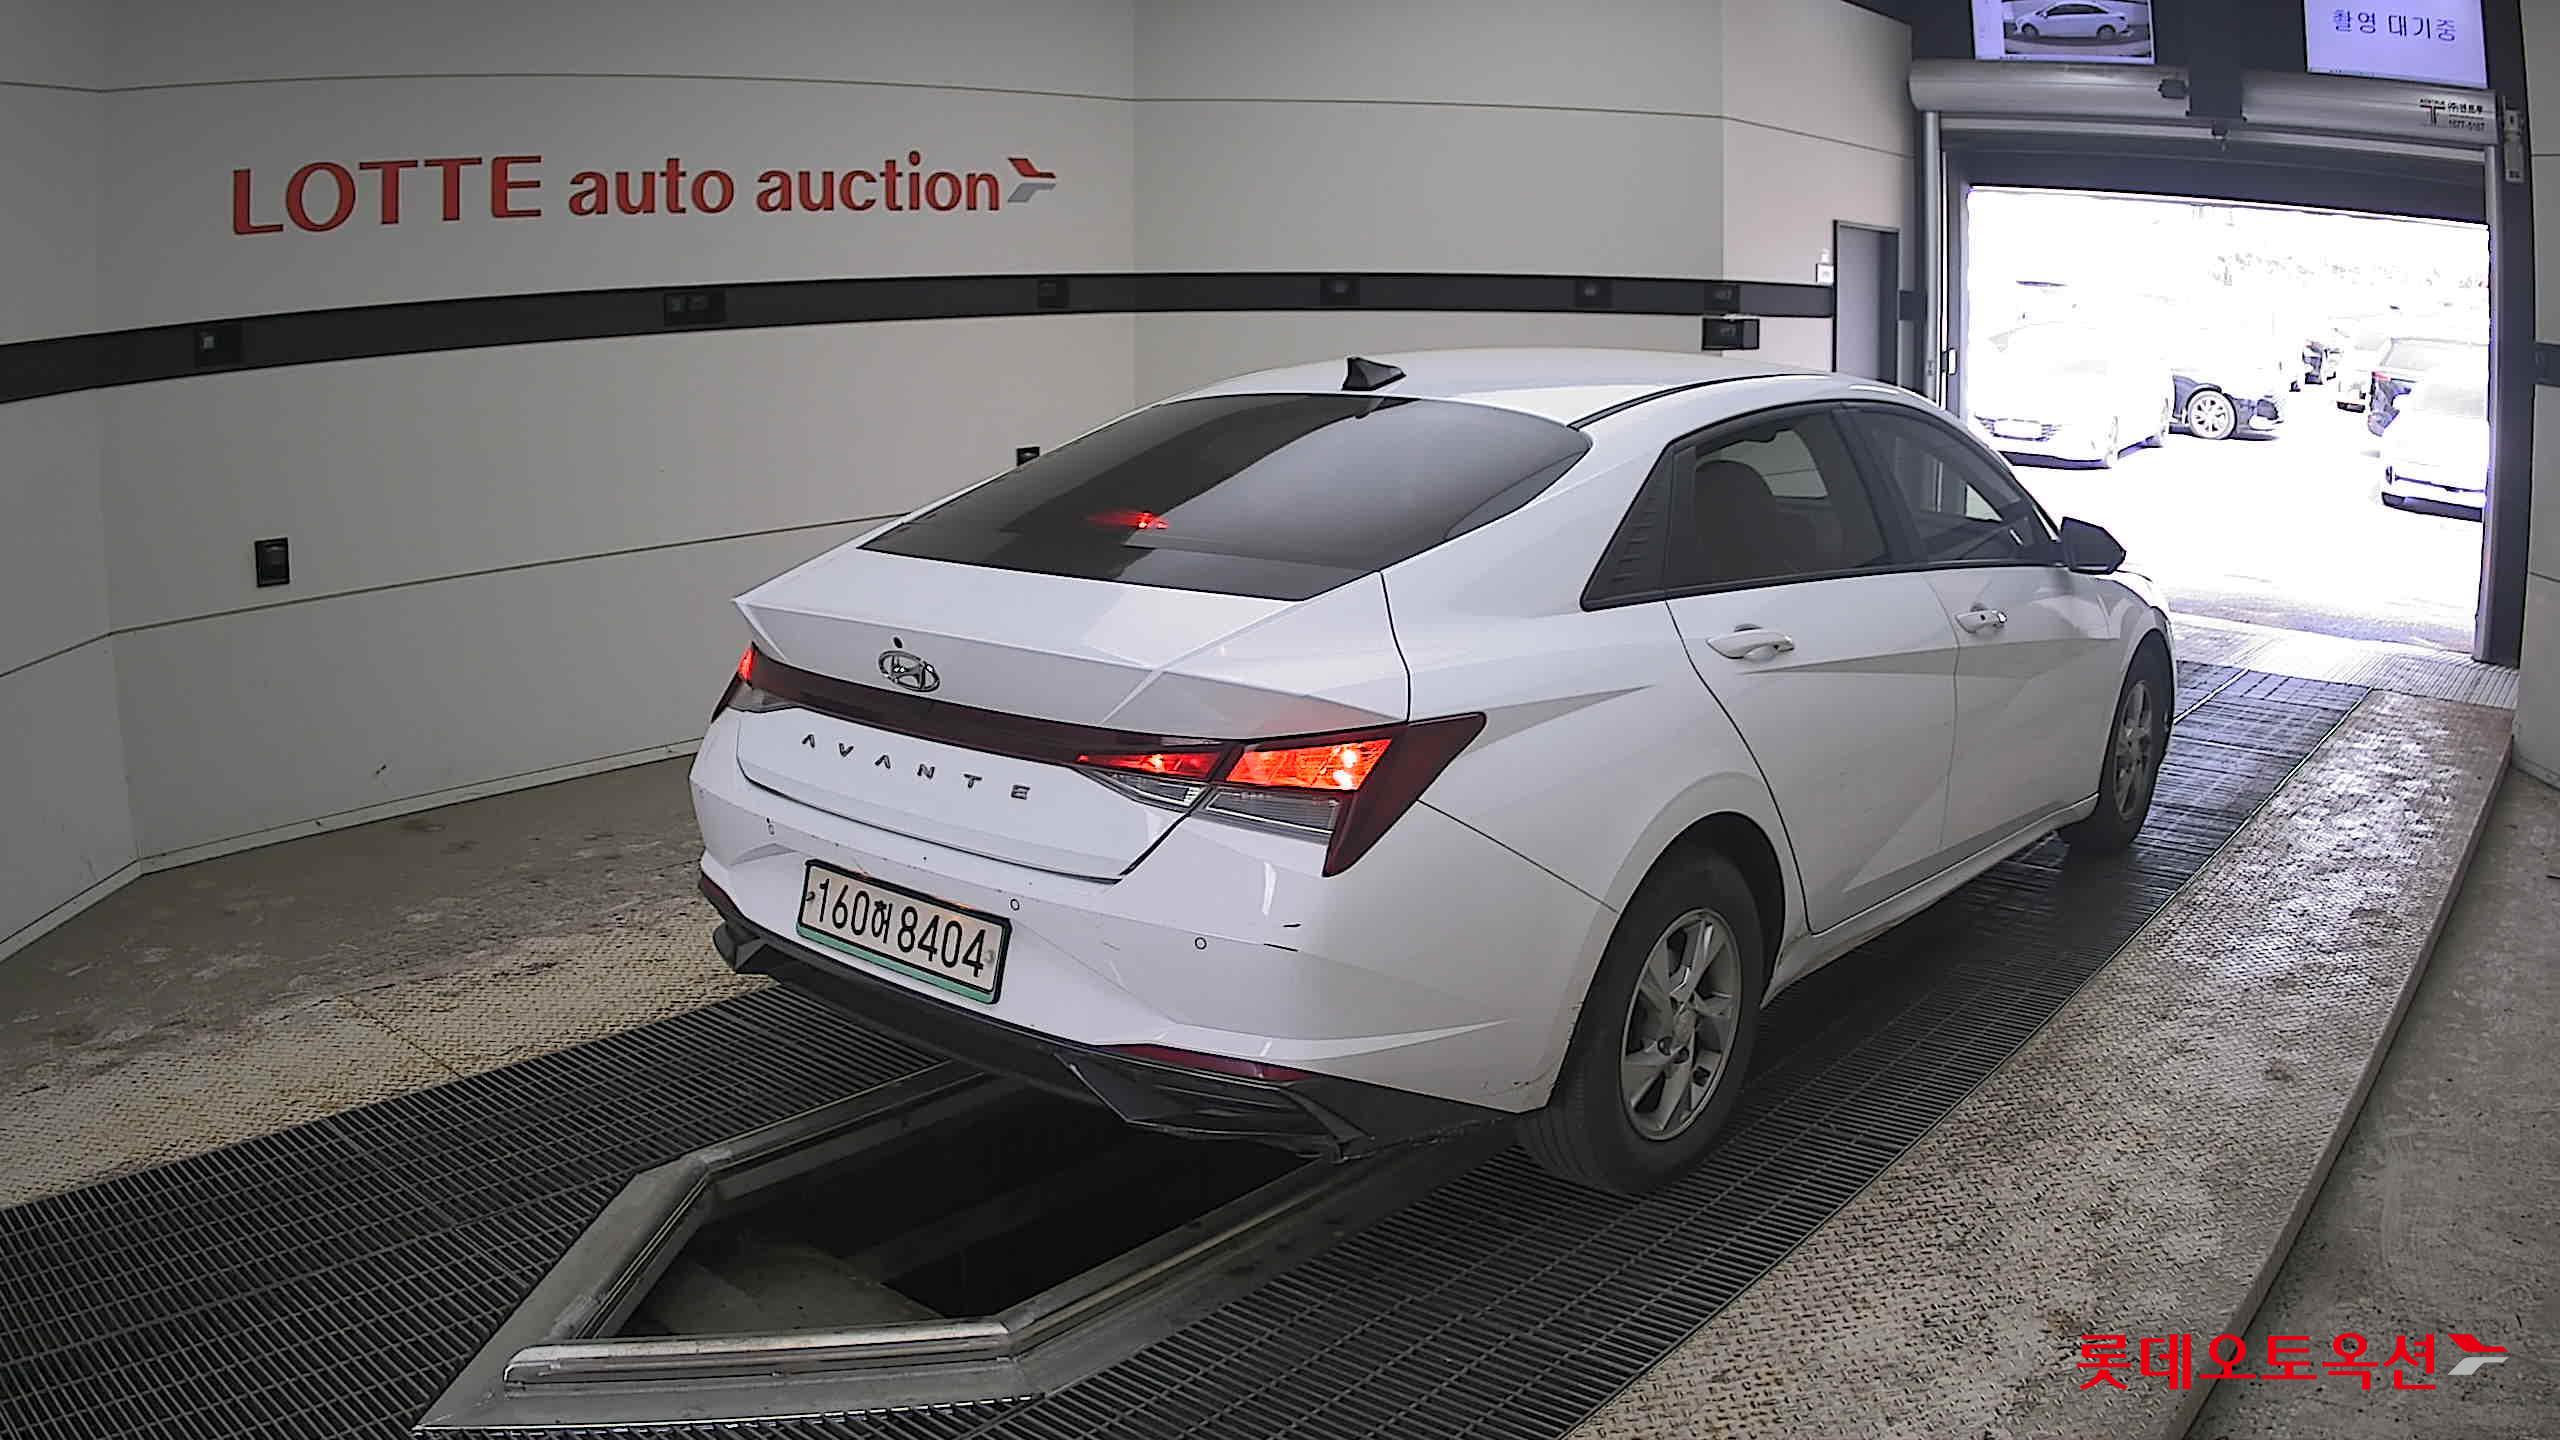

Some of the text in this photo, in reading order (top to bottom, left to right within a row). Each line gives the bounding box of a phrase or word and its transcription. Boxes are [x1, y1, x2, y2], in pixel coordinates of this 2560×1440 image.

[2333, 9, 2457, 42] 촬영 대기중
[232, 149, 1001, 236] LOTTE auto auction
[801, 733, 1031, 801] AVANTE
